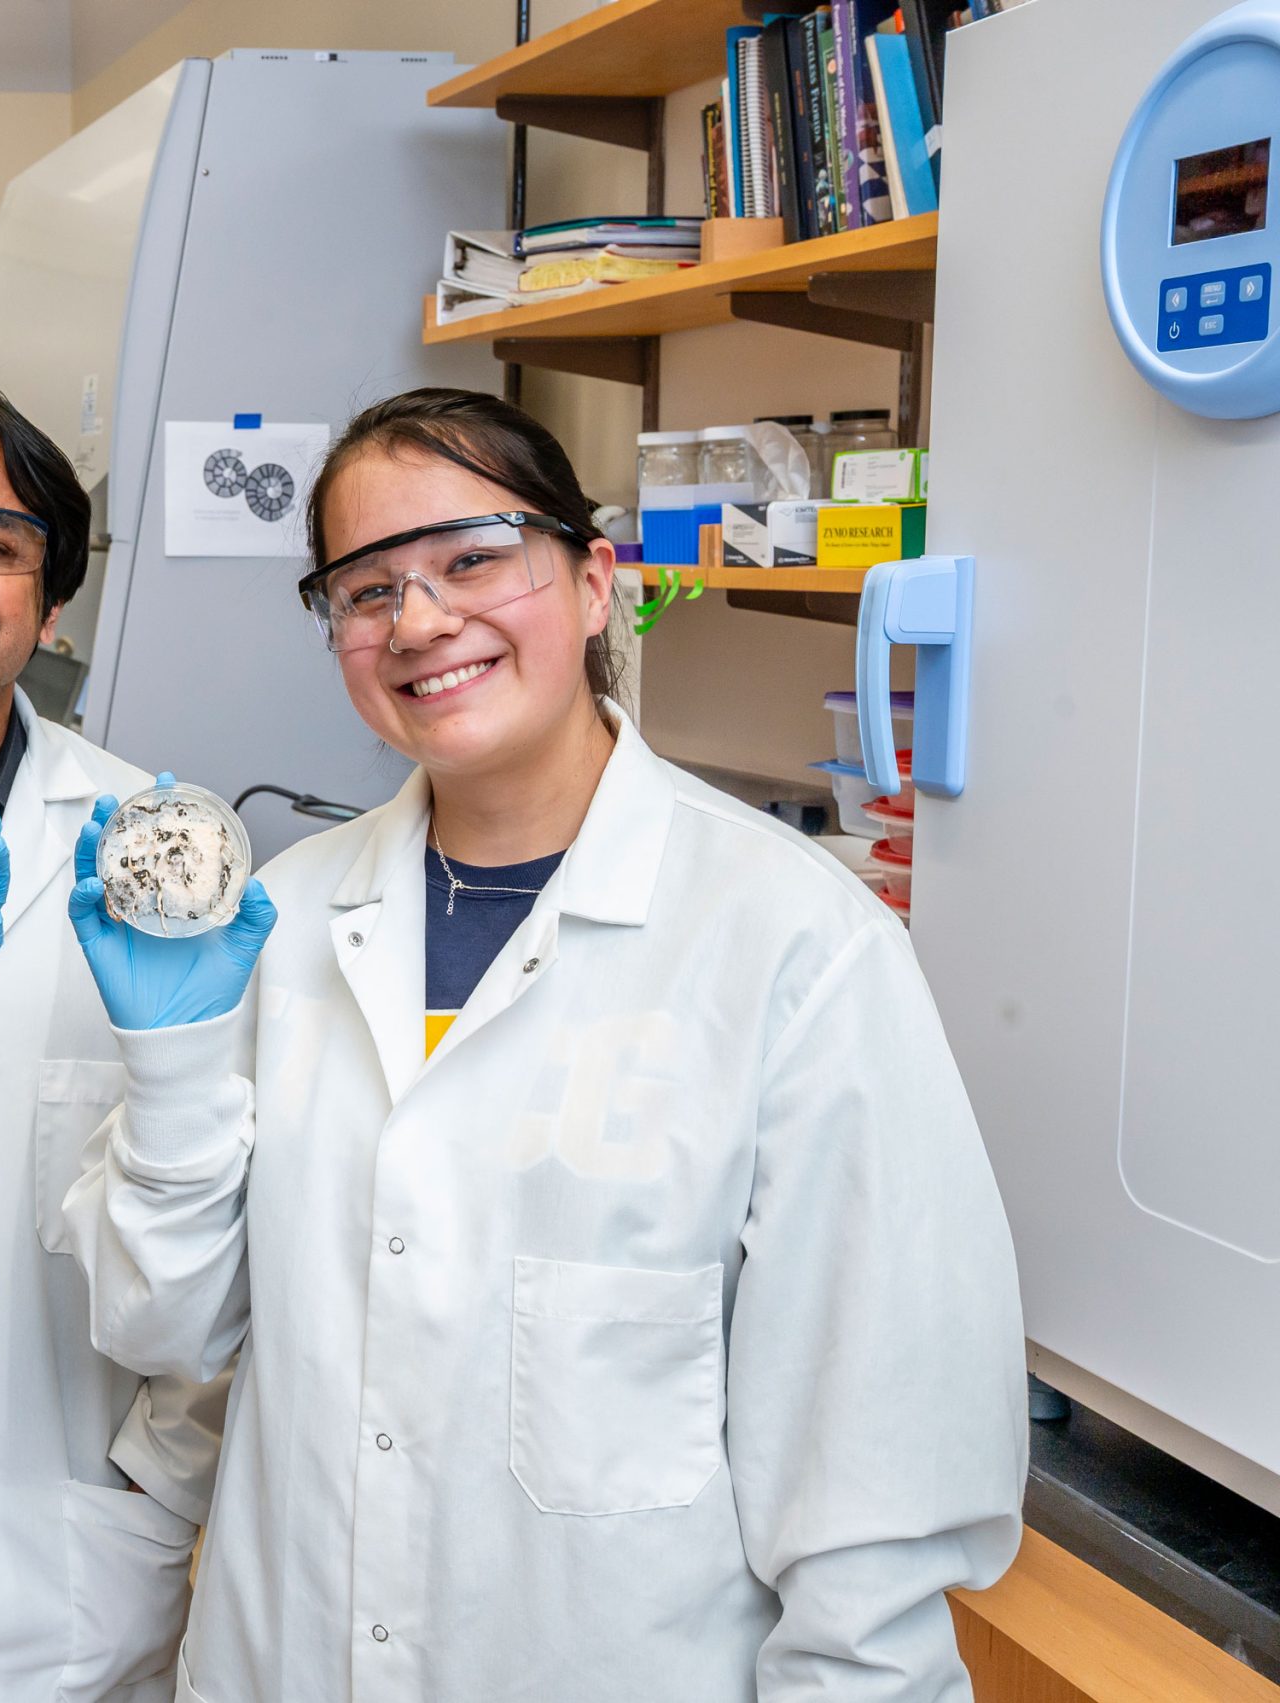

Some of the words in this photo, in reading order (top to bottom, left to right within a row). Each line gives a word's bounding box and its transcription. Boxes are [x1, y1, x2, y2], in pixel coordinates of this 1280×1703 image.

[804, 19, 817, 85] PRICELESS
[810, 87, 822, 143] FLORIDA
[1204, 321, 1217, 330] ESC
[823, 527, 848, 539] ZYMO
[849, 526, 893, 538] RESEARCH
